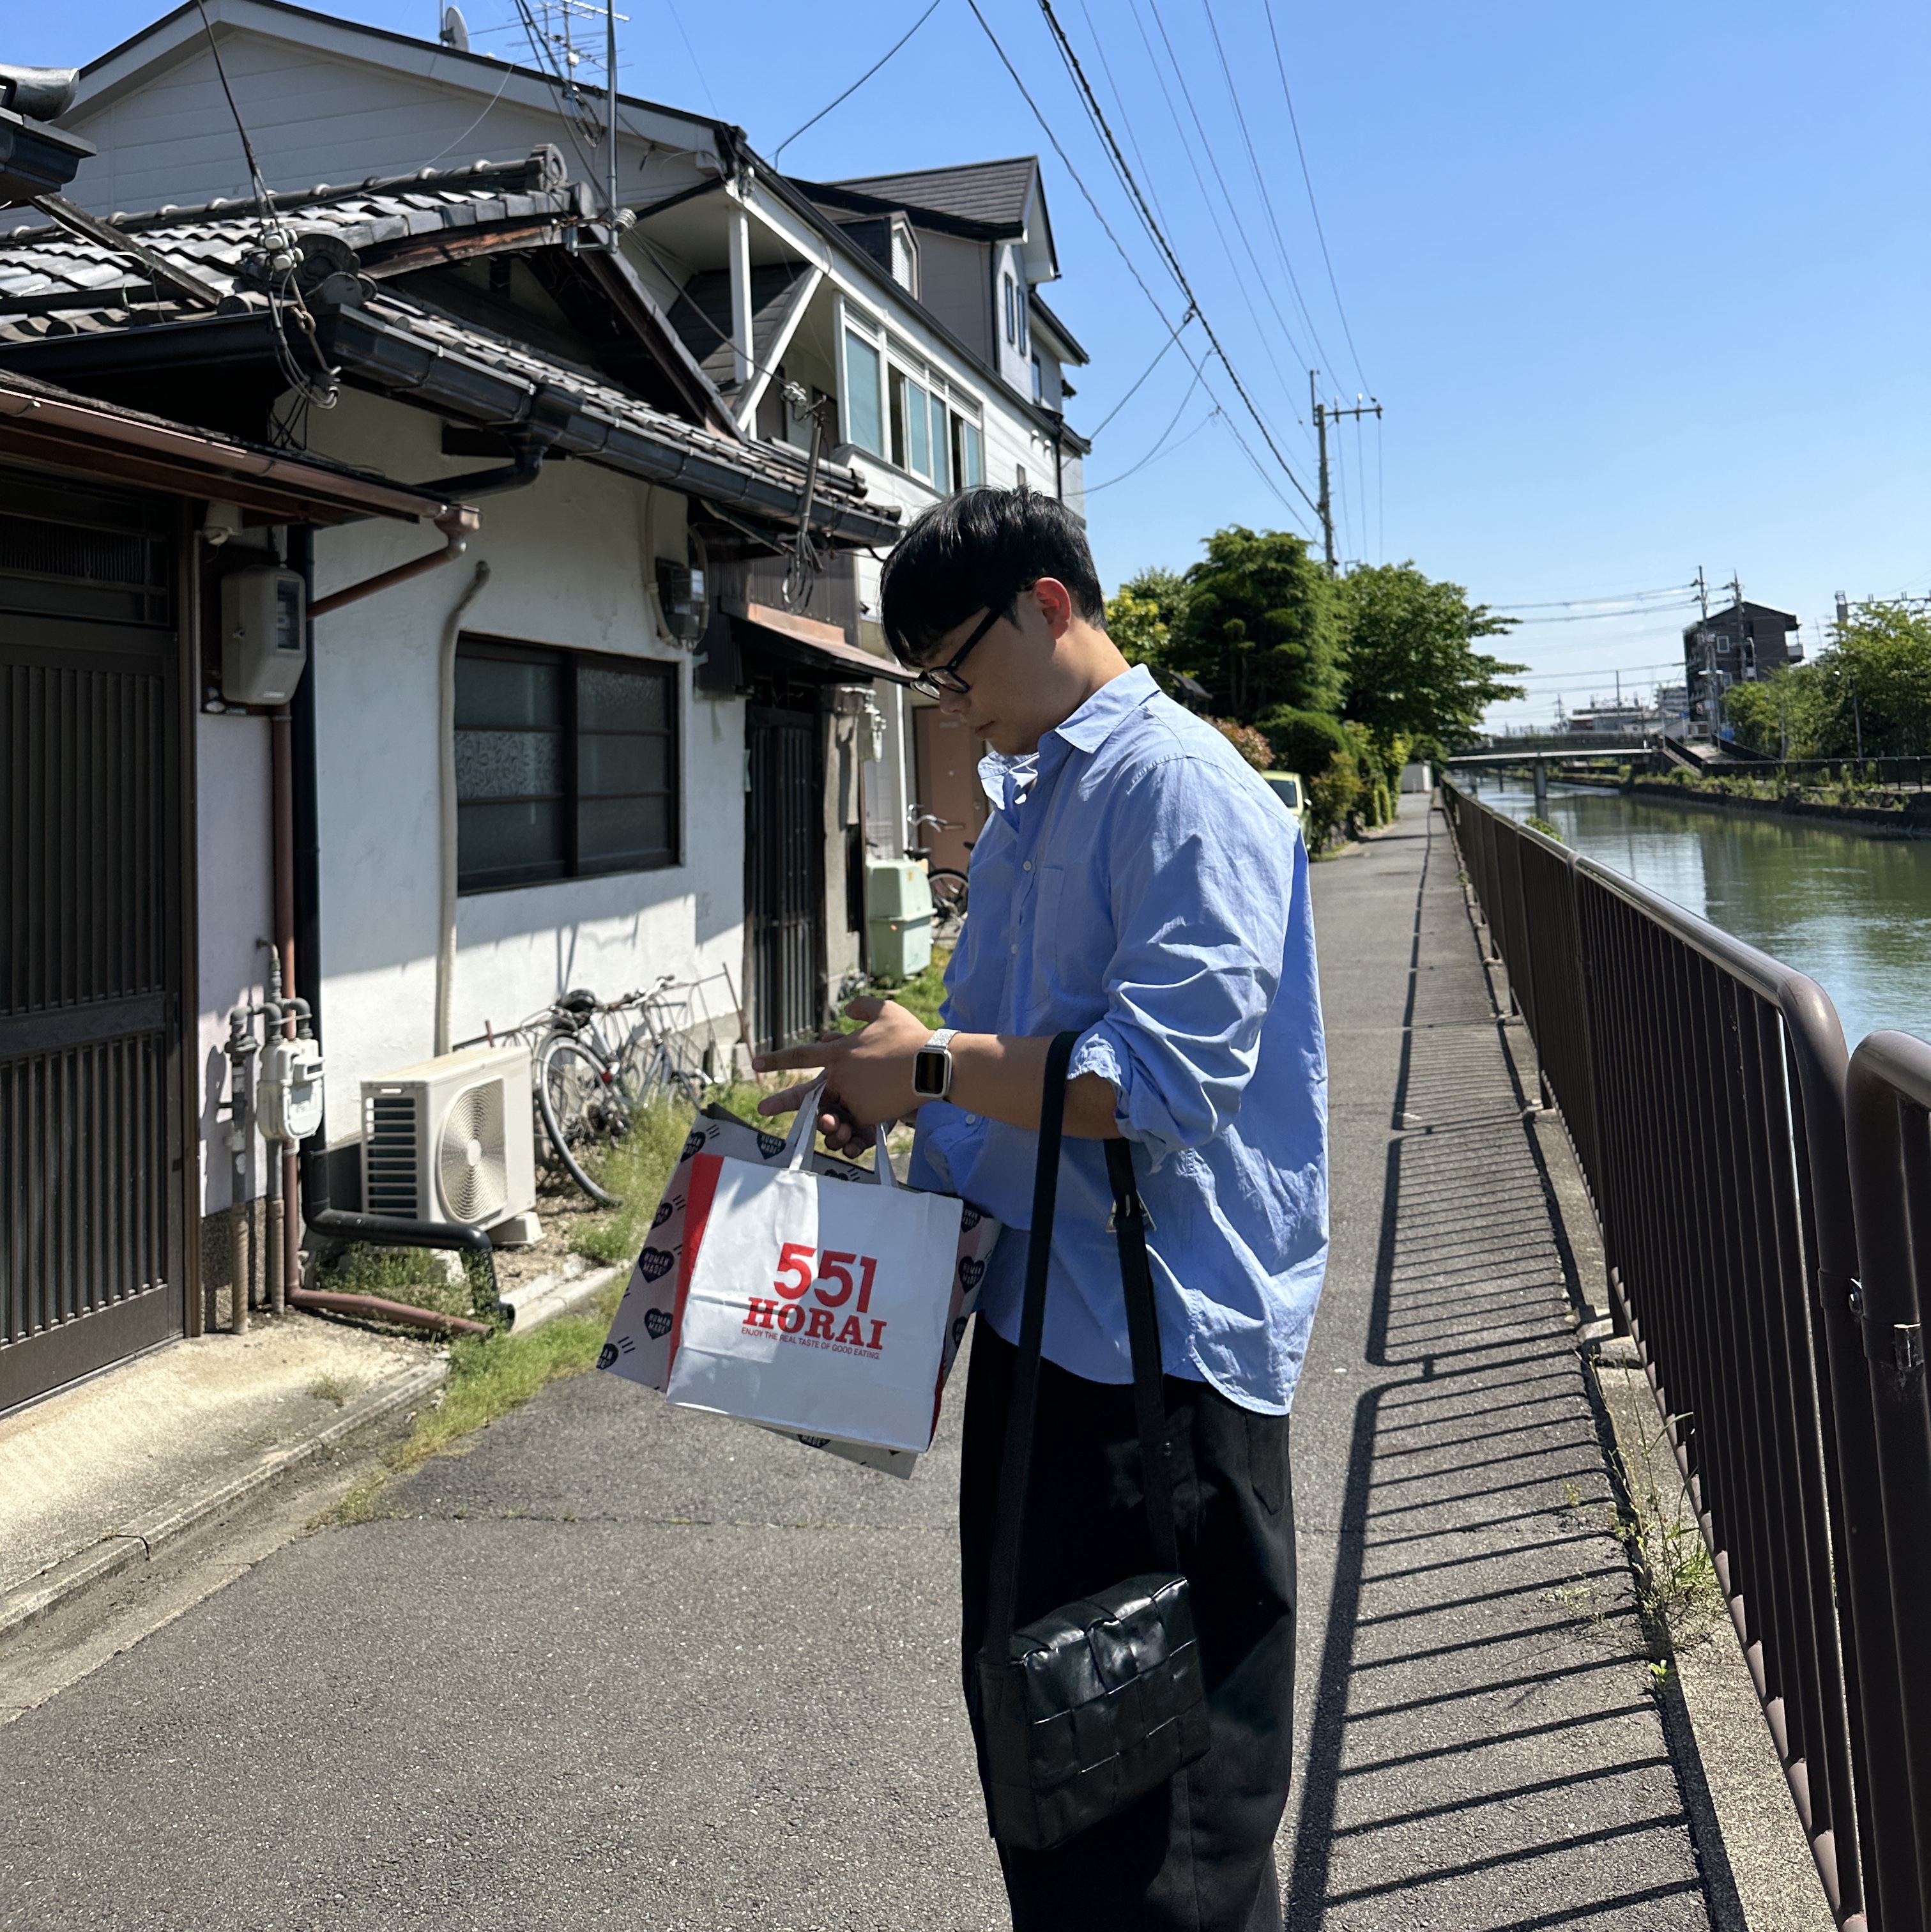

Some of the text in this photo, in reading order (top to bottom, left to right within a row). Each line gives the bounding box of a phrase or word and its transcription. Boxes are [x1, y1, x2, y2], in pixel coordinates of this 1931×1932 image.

[645, 1252, 669, 1266] HUMAN
[643, 1262, 663, 1276] MADE
[774, 1242, 878, 1314] 551
[649, 1314, 671, 1327] HUMAN
[743, 1297, 887, 1350] HORAI
[648, 1322, 665, 1334] MADE
[742, 1327, 763, 1337] ENJOY
[765, 1331, 778, 1340] THE
[779, 1334, 797, 1344] REAL
[798, 1337, 820, 1349] TASTE
[821, 1342, 831, 1350] OF
[832, 1344, 853, 1354] GOOD
